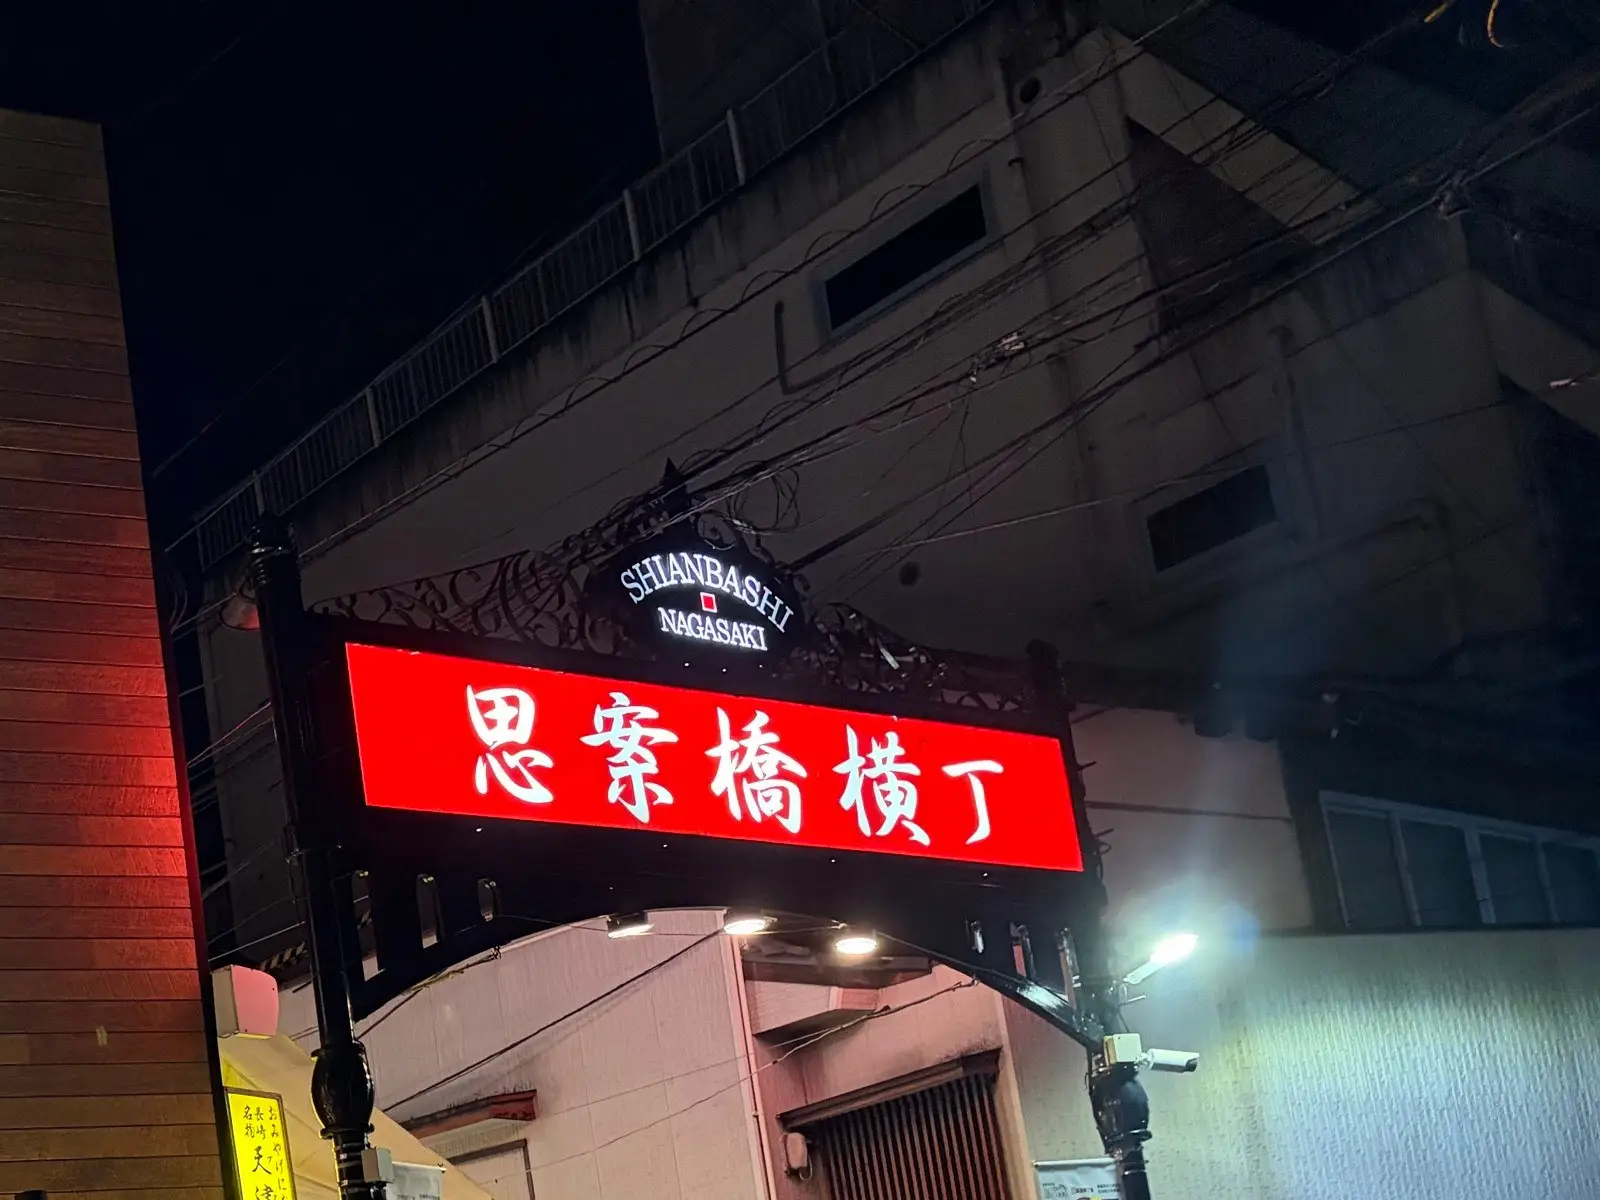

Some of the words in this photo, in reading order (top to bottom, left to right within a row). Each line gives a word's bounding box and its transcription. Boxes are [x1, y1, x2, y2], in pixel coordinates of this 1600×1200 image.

[620, 551, 795, 634] SHIANBASHI
[657, 606, 769, 652] NAGASAKI
[465, 684, 1004, 847] 思案橋横丁
